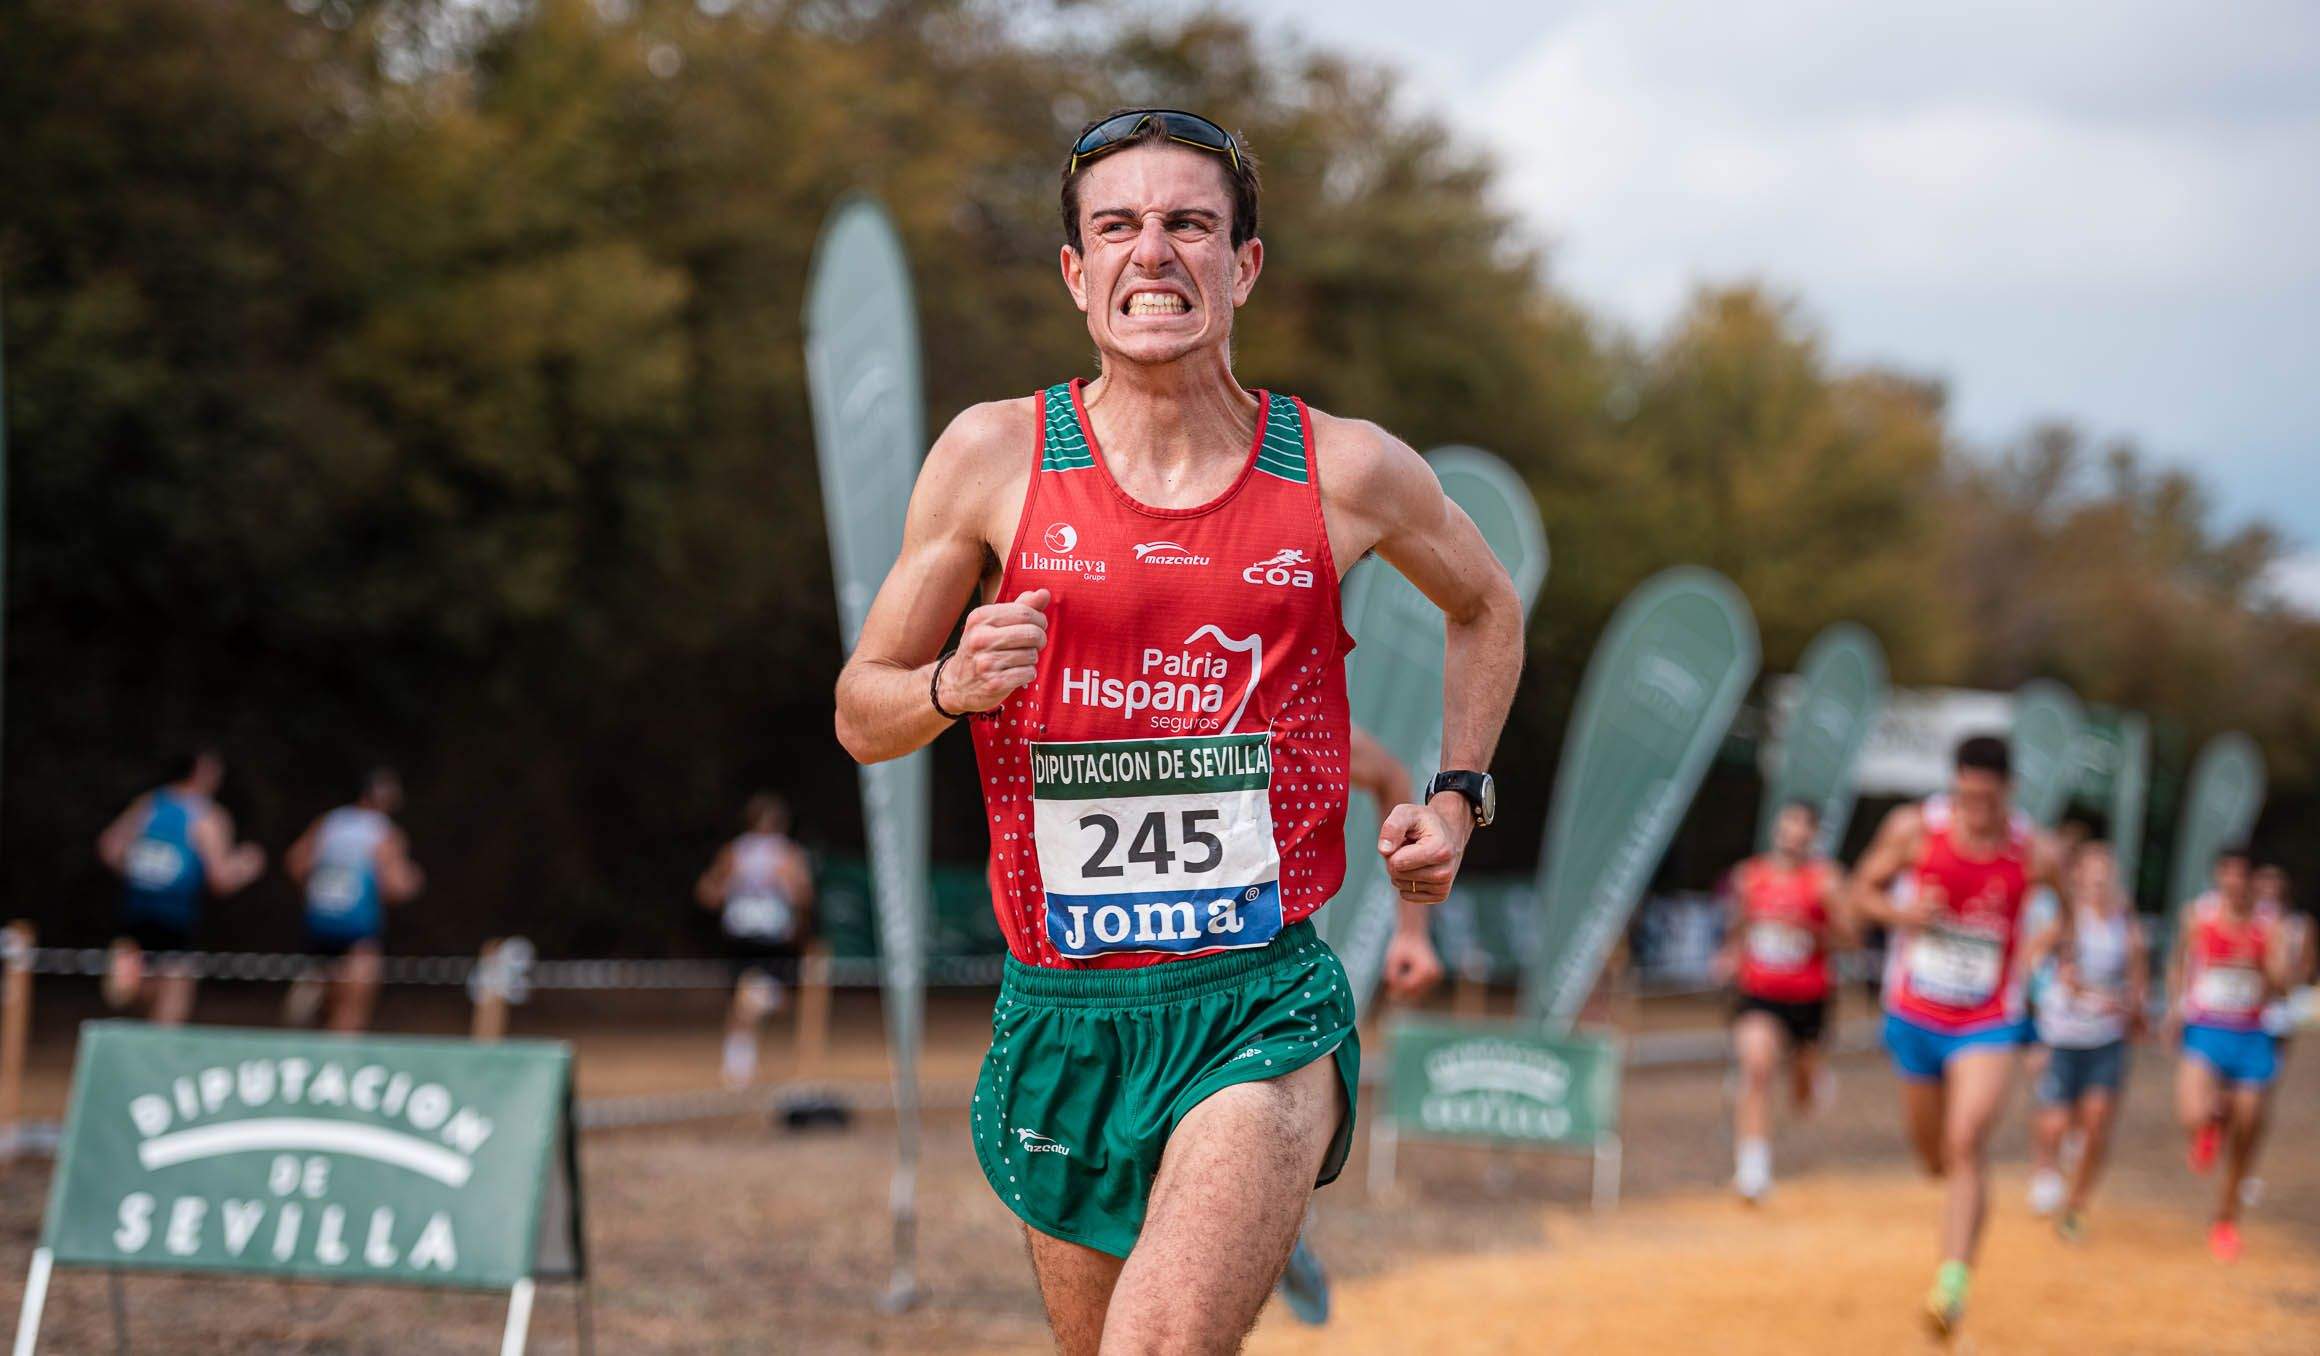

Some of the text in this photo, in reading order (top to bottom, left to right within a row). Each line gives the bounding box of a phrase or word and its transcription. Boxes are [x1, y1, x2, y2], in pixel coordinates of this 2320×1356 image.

[1021, 552, 1105, 573] Llamieva
[1084, 573, 1105, 581] Grupo
[1243, 566, 1313, 588] coa
[1142, 648, 1228, 679] Patria
[1062, 667, 1224, 719] Hispana
[1150, 714, 1220, 732] seguros
[1035, 745, 1269, 785] DIPUTACION DE SEVILLA
[1079, 809, 1223, 878] 245
[129, 1056, 494, 1155] DIPUTACION
[268, 1155, 332, 1197] DE
[113, 1191, 459, 1271] SEVILLA
